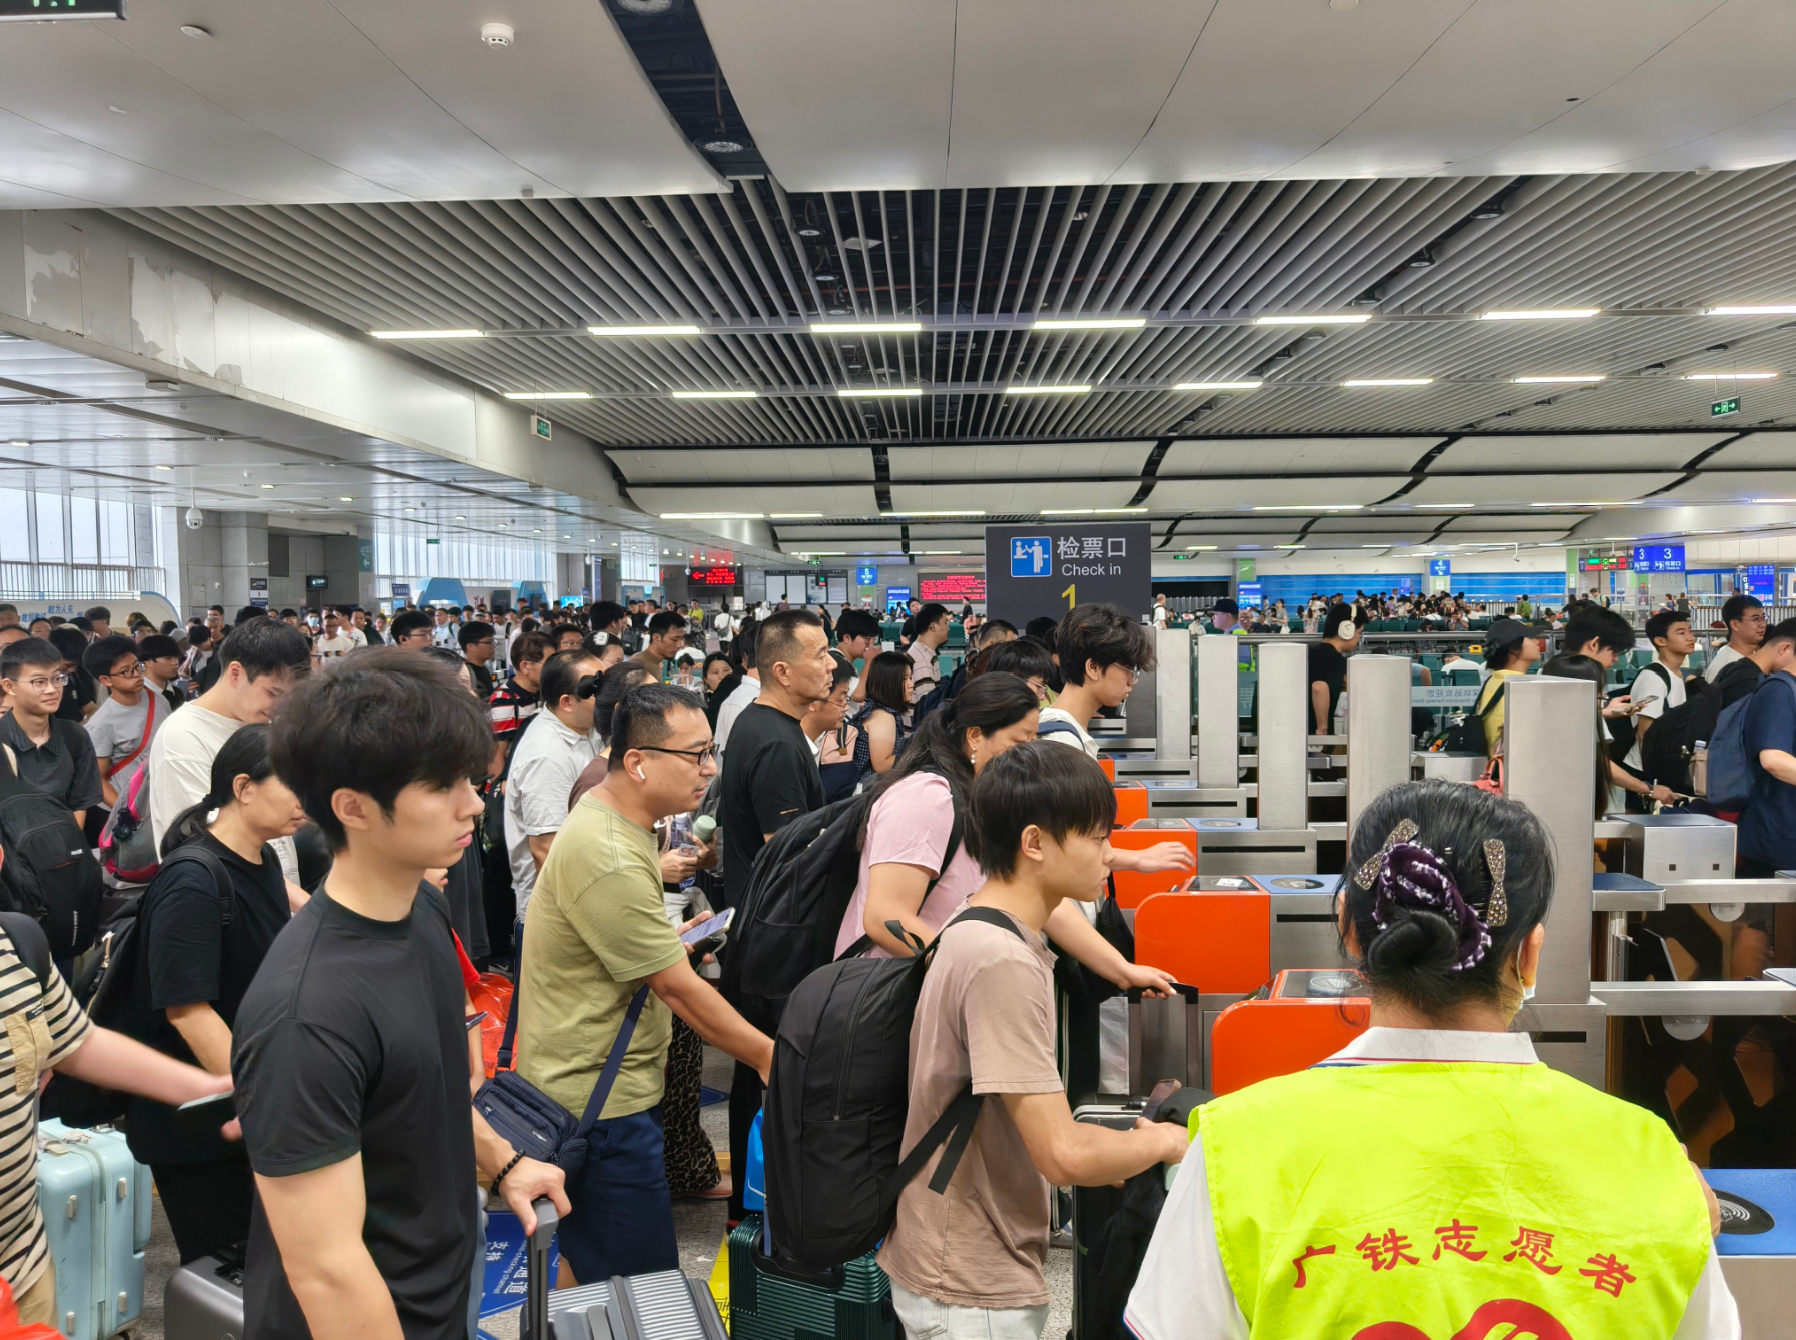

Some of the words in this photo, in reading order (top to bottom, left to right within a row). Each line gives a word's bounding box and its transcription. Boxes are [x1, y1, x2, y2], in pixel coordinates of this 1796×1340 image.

[1057, 536, 1126, 559] 检票口
[1639, 548, 1645, 560] 3
[1663, 547, 1672, 559] 3
[1062, 564, 1105, 576] Check
[1109, 563, 1121, 575] in
[1061, 584, 1076, 611] 1
[1292, 1218, 1637, 1298] 广铁志愿者
[492, 1273, 510, 1294] channel
